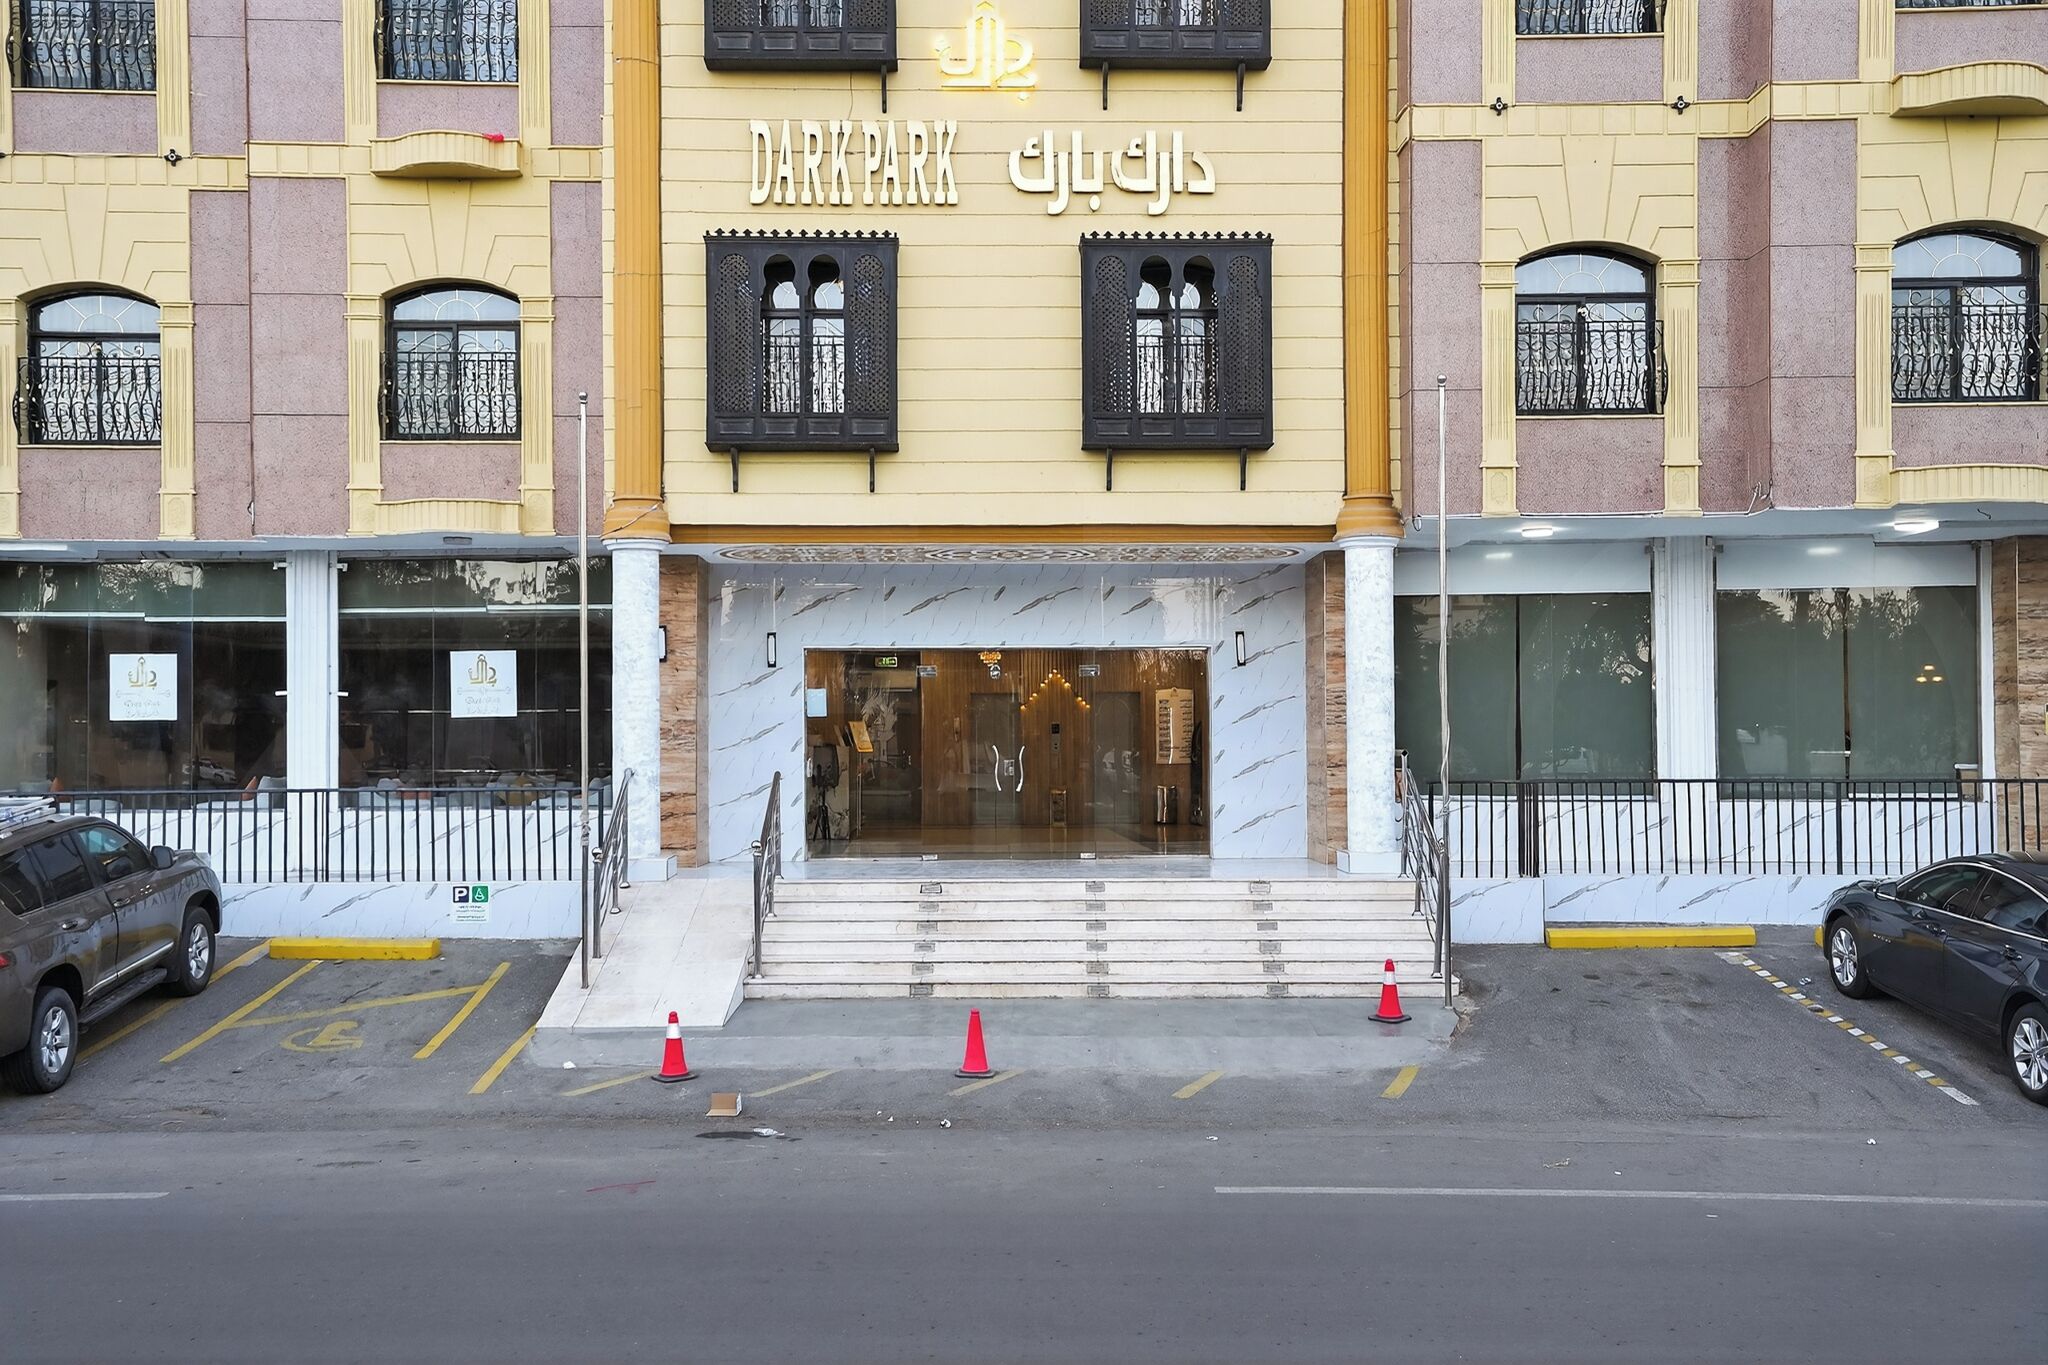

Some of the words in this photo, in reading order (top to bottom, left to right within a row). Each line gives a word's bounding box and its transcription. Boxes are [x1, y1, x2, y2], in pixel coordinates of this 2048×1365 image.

[750, 119, 853, 205] DARK
[862, 119, 959, 205] PARK
[1008, 129, 1104, 216] بارك
[1110, 129, 1216, 216] دارك
[454, 888, 468, 902] P
